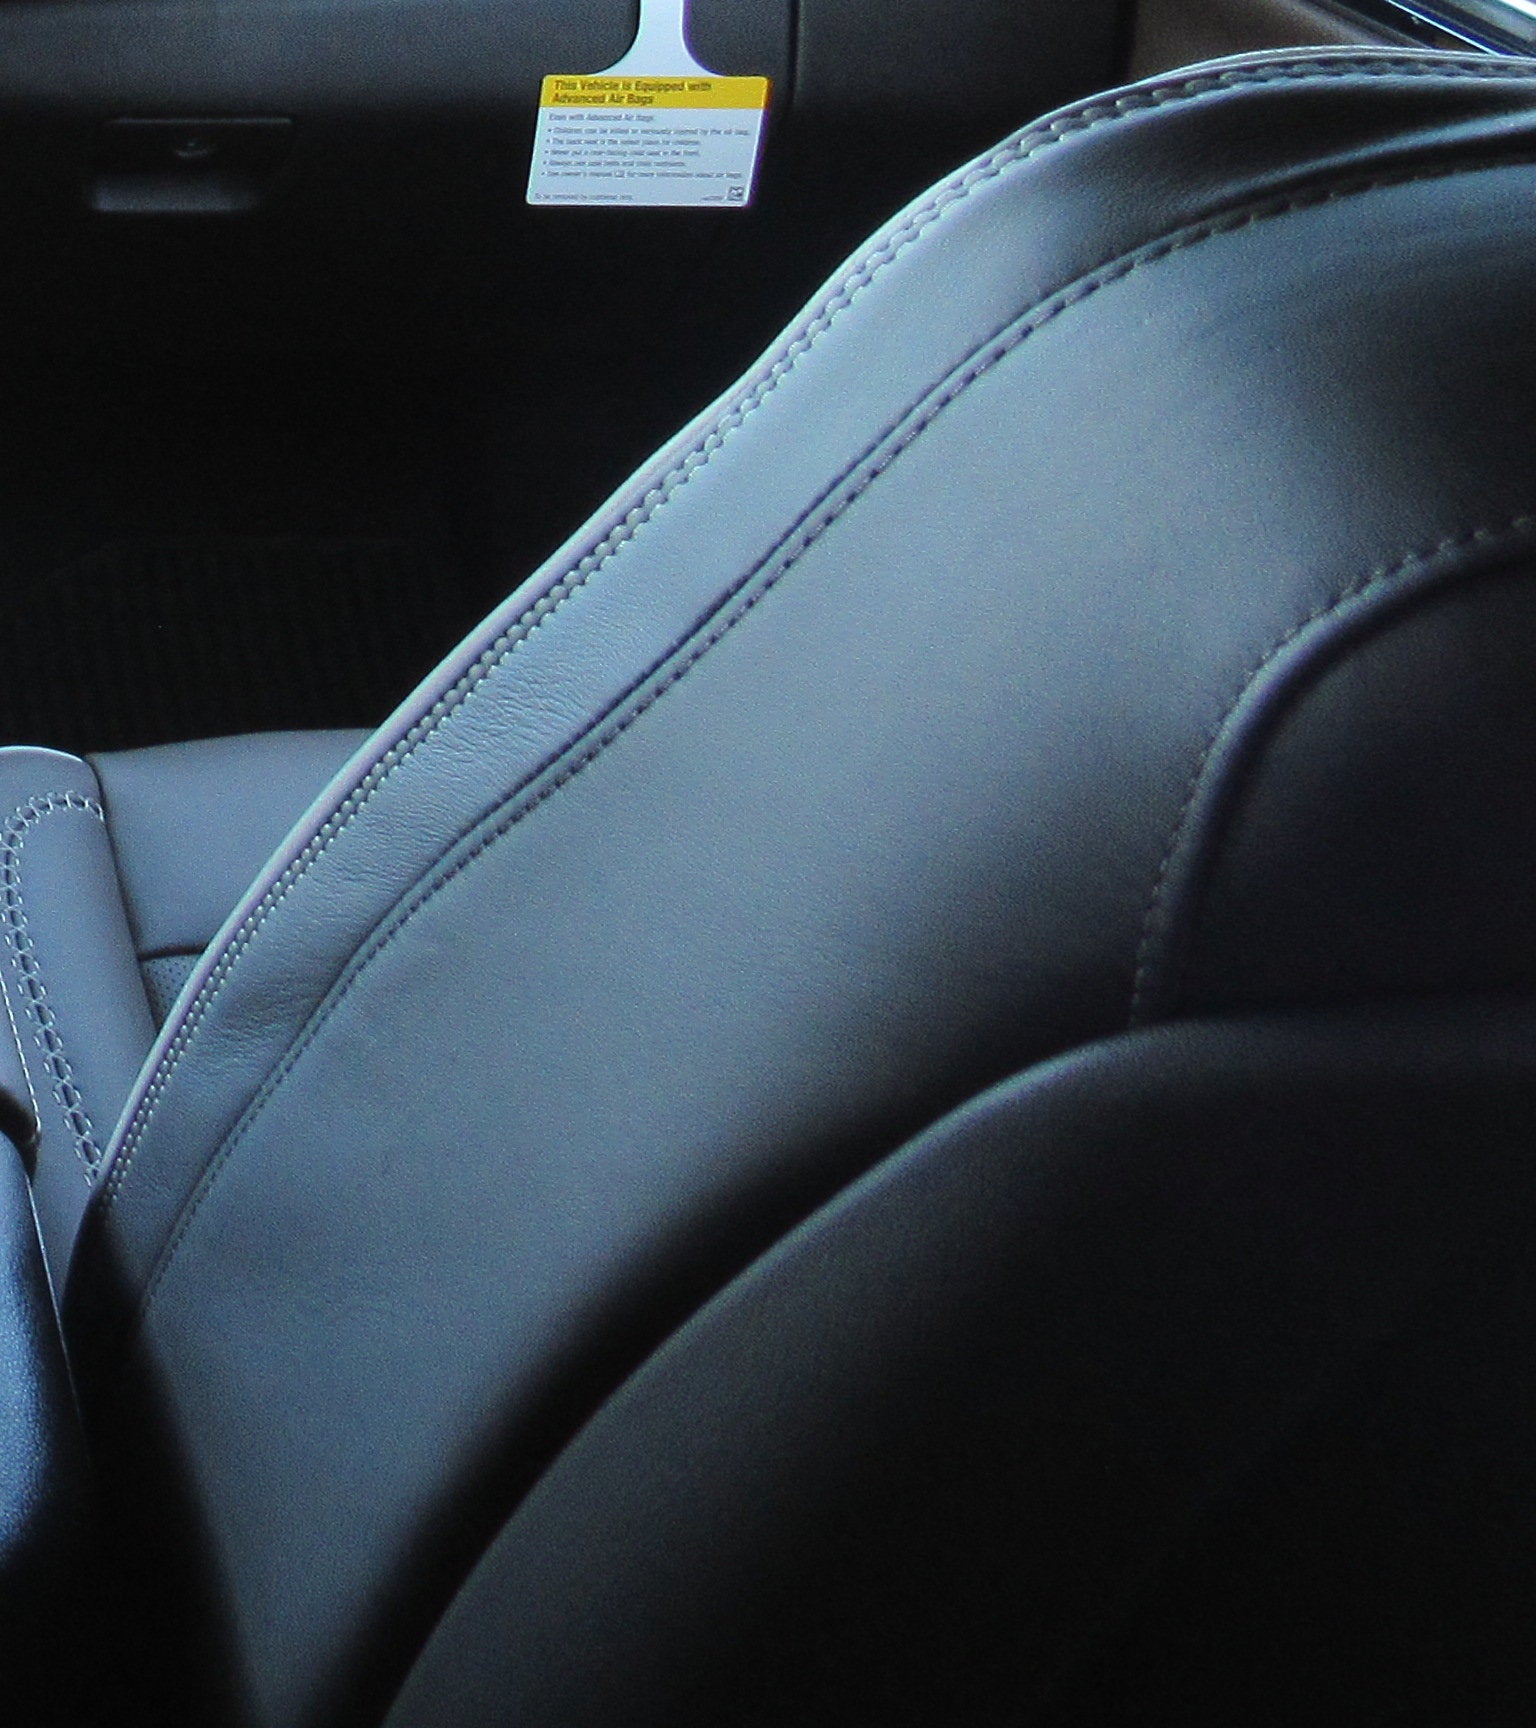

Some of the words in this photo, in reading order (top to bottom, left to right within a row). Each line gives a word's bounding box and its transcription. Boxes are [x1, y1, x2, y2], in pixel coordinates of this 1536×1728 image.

[579, 80, 620, 91] Vehicle
[635, 80, 685, 93] Equipped
[552, 92, 607, 104] Advanced
[609, 93, 625, 104] Air
[627, 93, 653, 106] Bags
